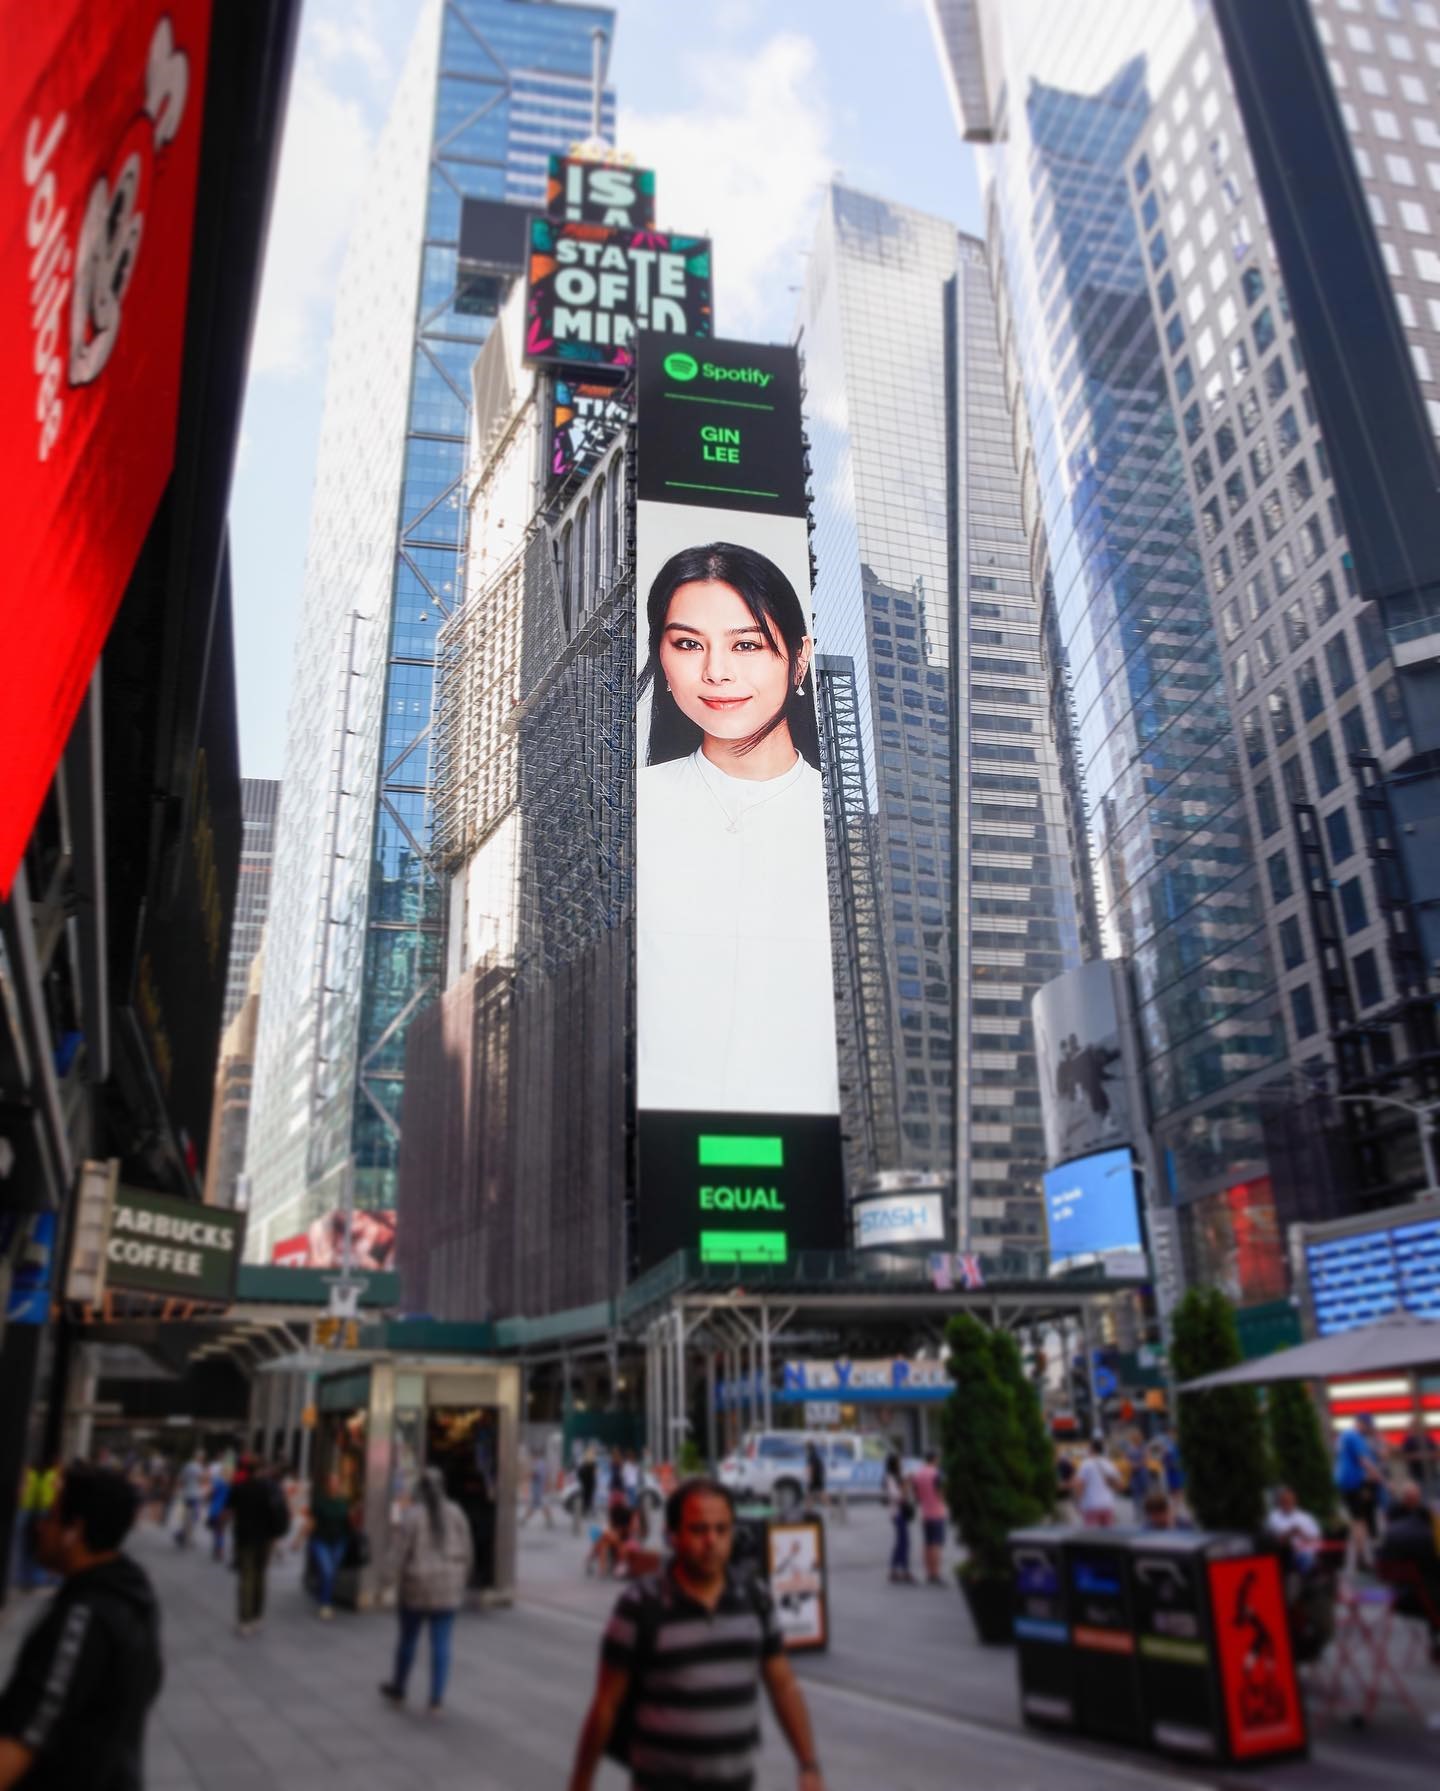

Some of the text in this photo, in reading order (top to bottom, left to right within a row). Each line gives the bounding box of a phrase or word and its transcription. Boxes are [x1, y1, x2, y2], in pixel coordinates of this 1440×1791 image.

[23, 111, 71, 462] Jollibee
[554, 267, 630, 310] OF
[555, 238, 687, 315] STATE
[702, 362, 772, 387] Spotify
[700, 425, 741, 445] GIN
[703, 445, 741, 464] LEE
[699, 1186, 785, 1211] EQUAL
[112, 1205, 235, 1250] ARBUCKS
[107, 1237, 204, 1277] COFFEE
